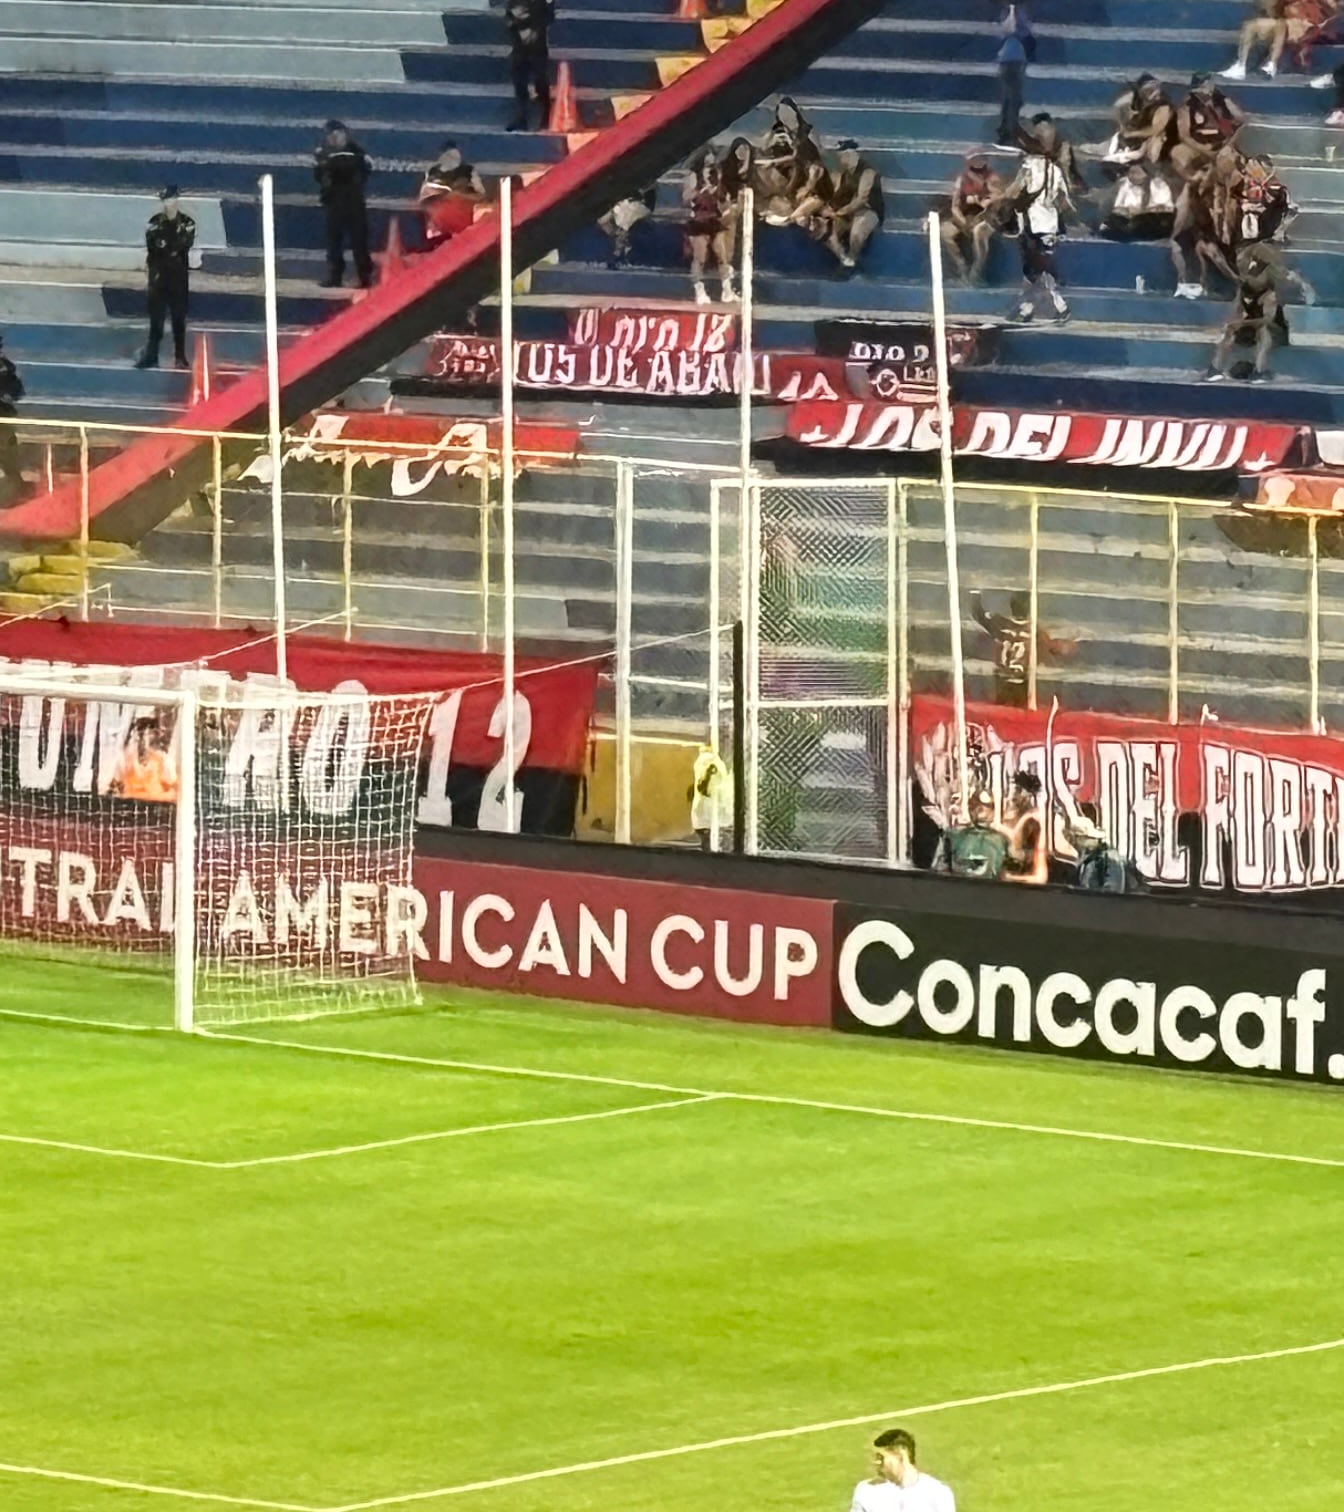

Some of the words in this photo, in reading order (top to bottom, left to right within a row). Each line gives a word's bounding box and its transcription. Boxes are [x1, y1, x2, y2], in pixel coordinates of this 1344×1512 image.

[416, 687, 534, 834] 12
[221, 870, 628, 988] AMERICAN
[650, 911, 819, 1002] CUP
